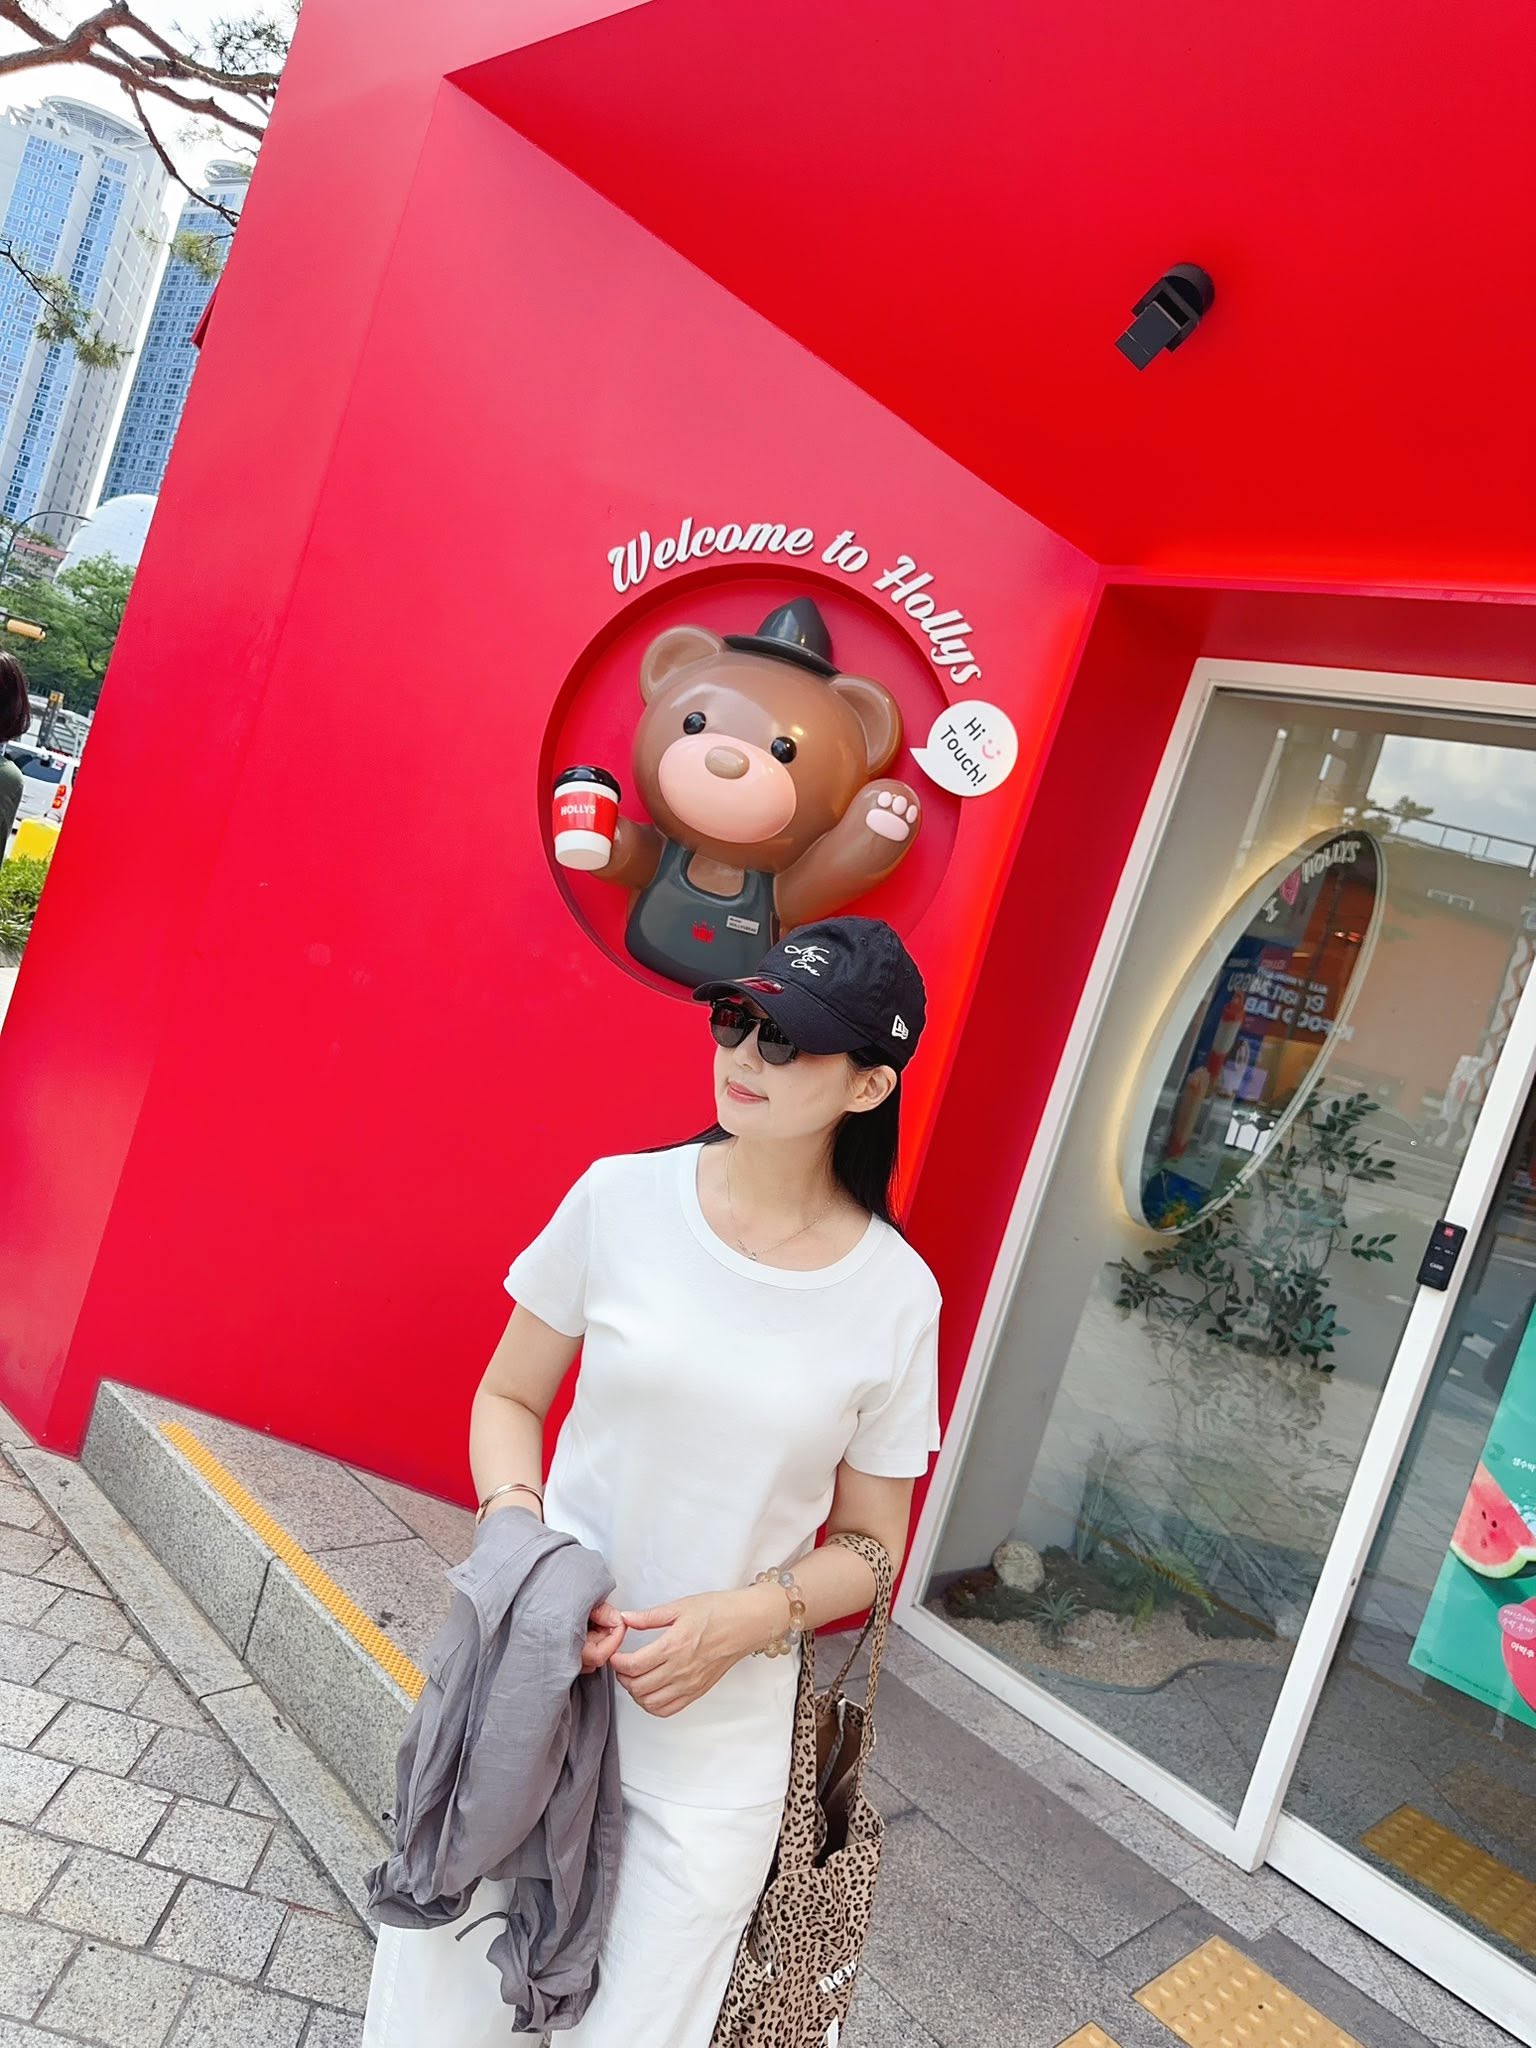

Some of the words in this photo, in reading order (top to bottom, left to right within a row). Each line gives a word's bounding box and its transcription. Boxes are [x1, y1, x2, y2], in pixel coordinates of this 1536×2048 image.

[607, 516, 814, 594] Welcome
[820, 530, 869, 574] to
[871, 554, 982, 686] Hollys
[963, 717, 986, 742] Hi
[940, 724, 987, 787] Touch!
[561, 804, 596, 817] HOLLYS
